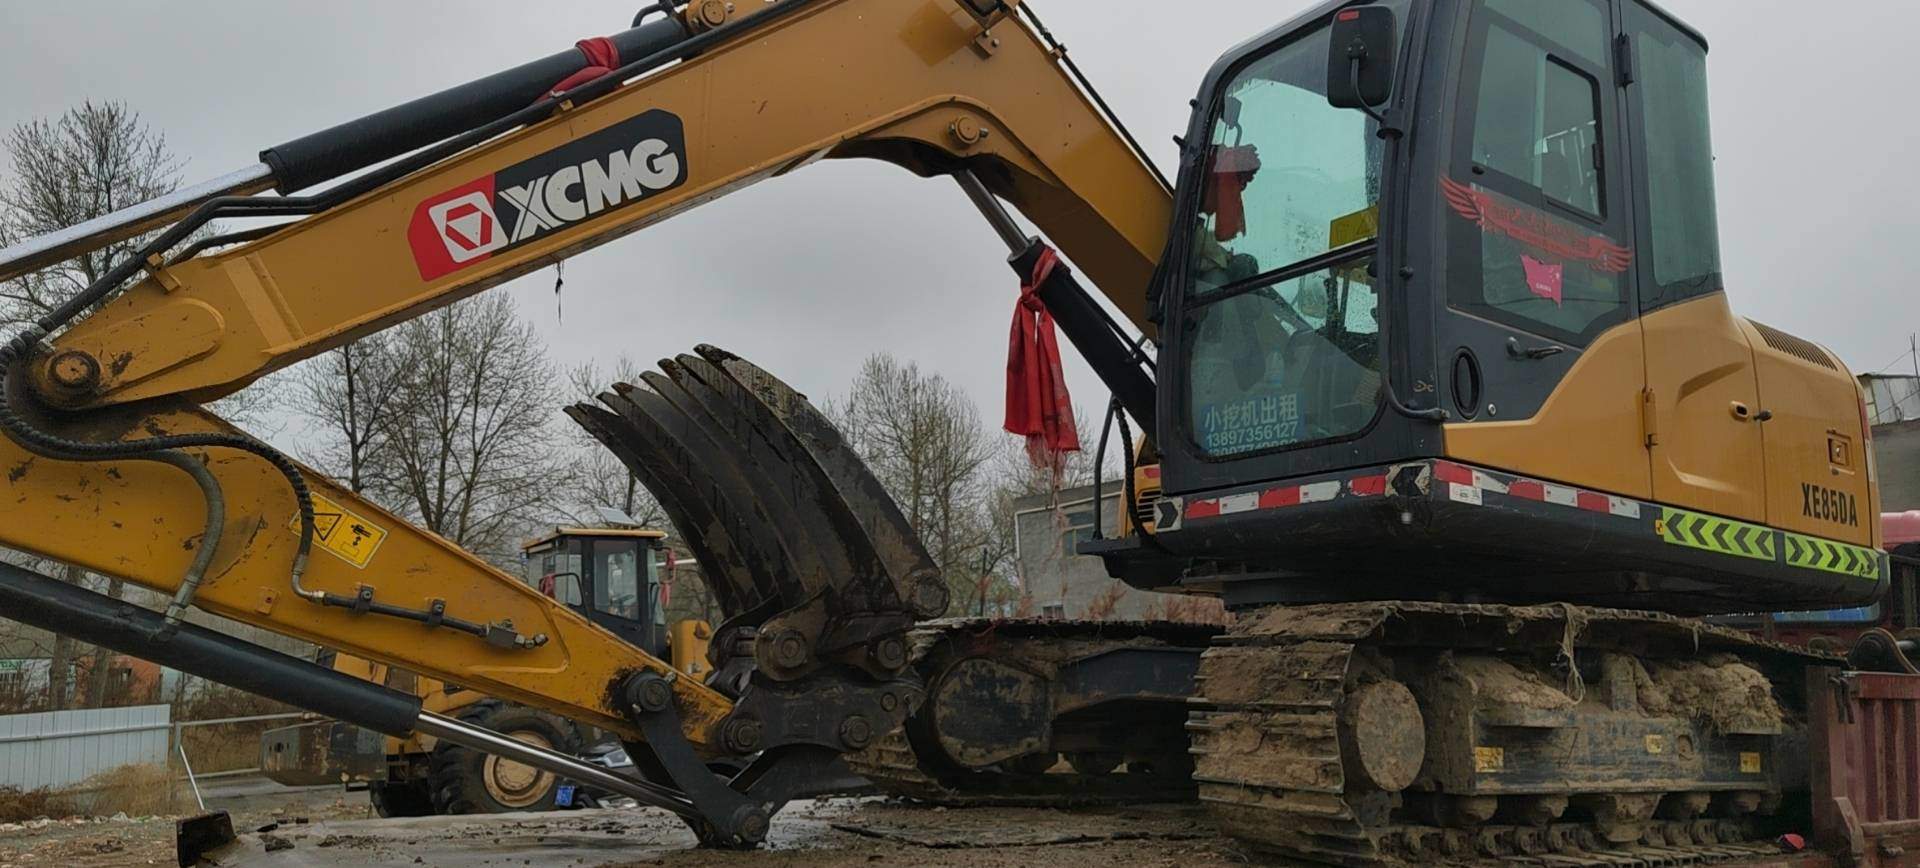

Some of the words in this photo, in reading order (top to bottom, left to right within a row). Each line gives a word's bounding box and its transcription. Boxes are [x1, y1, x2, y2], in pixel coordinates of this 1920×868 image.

[498, 138, 680, 244] XCMG
[1204, 393, 1299, 432] 小挖机出租
[1206, 421, 1299, 448] 13897356127
[1801, 482, 1858, 527] XE85DA
